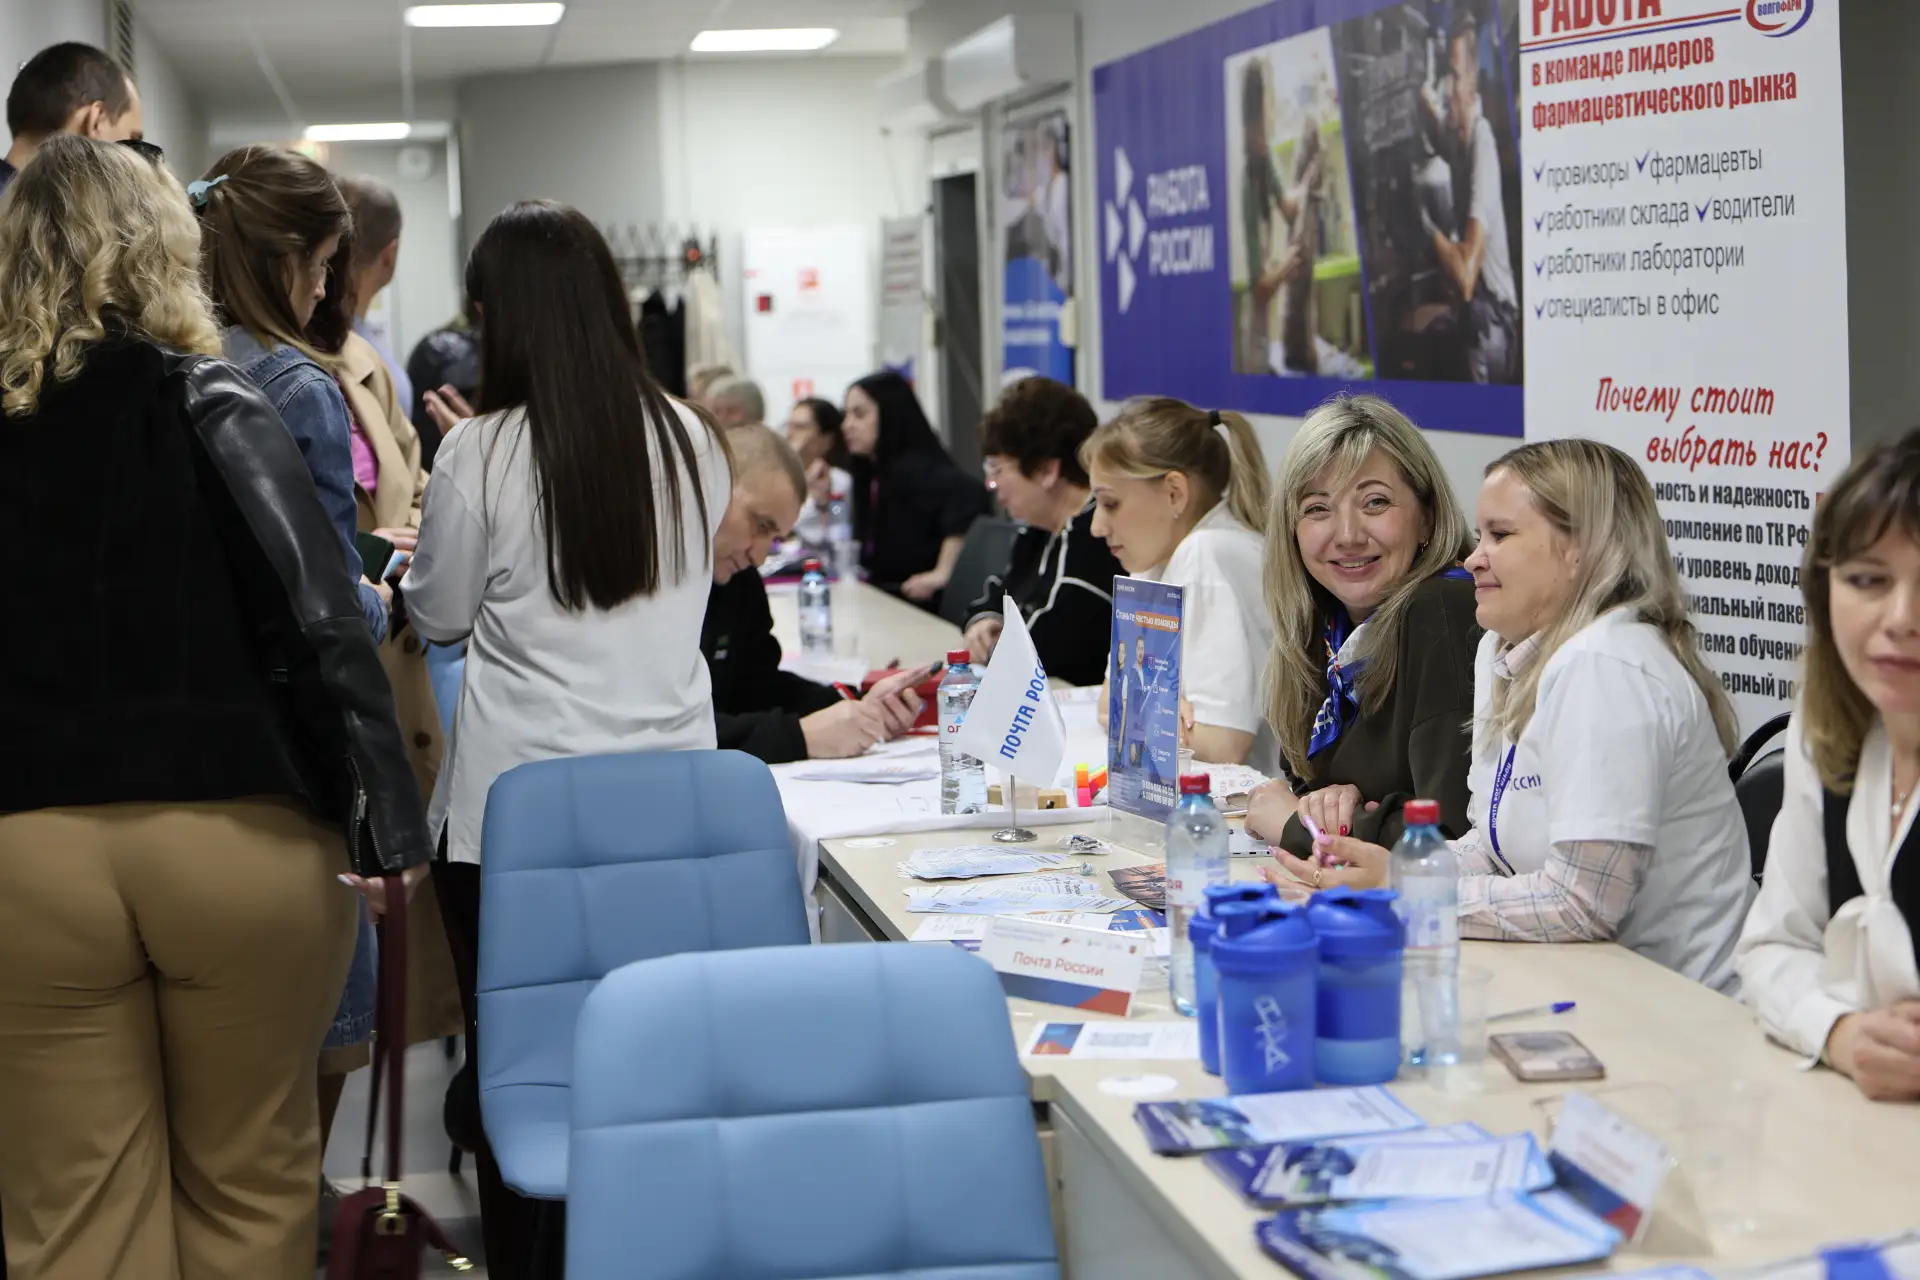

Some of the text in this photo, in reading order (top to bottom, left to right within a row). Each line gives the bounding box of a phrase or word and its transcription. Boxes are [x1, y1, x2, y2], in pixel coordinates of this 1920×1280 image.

[1532, 36, 1714, 87] в команде лидеров
[1532, 71, 1797, 132] фармацевтического рынка
[1547, 148, 1762, 193] провизоры фармацевты
[1547, 194, 1796, 238] работники склада водители
[1547, 242, 1745, 281] работники лаборатории
[1547, 287, 1720, 324] специалисты в офис
[1595, 376, 1775, 424] Почему стоит
[1646, 424, 1828, 473] выбрать нас?
[1652, 482, 1811, 510] ность и надежность
[1746, 524, 1764, 545] по
[1766, 522, 1784, 546] ТК
[1787, 524, 1810, 548] РФ
[1687, 557, 1752, 581] уровень
[1740, 633, 1807, 662] обучени
[1713, 670, 1775, 698] ерный
[999, 704, 1036, 760] ПОЧТА
[1511, 774, 1541, 791] ССИ
[1013, 951, 1105, 977] Почта России
